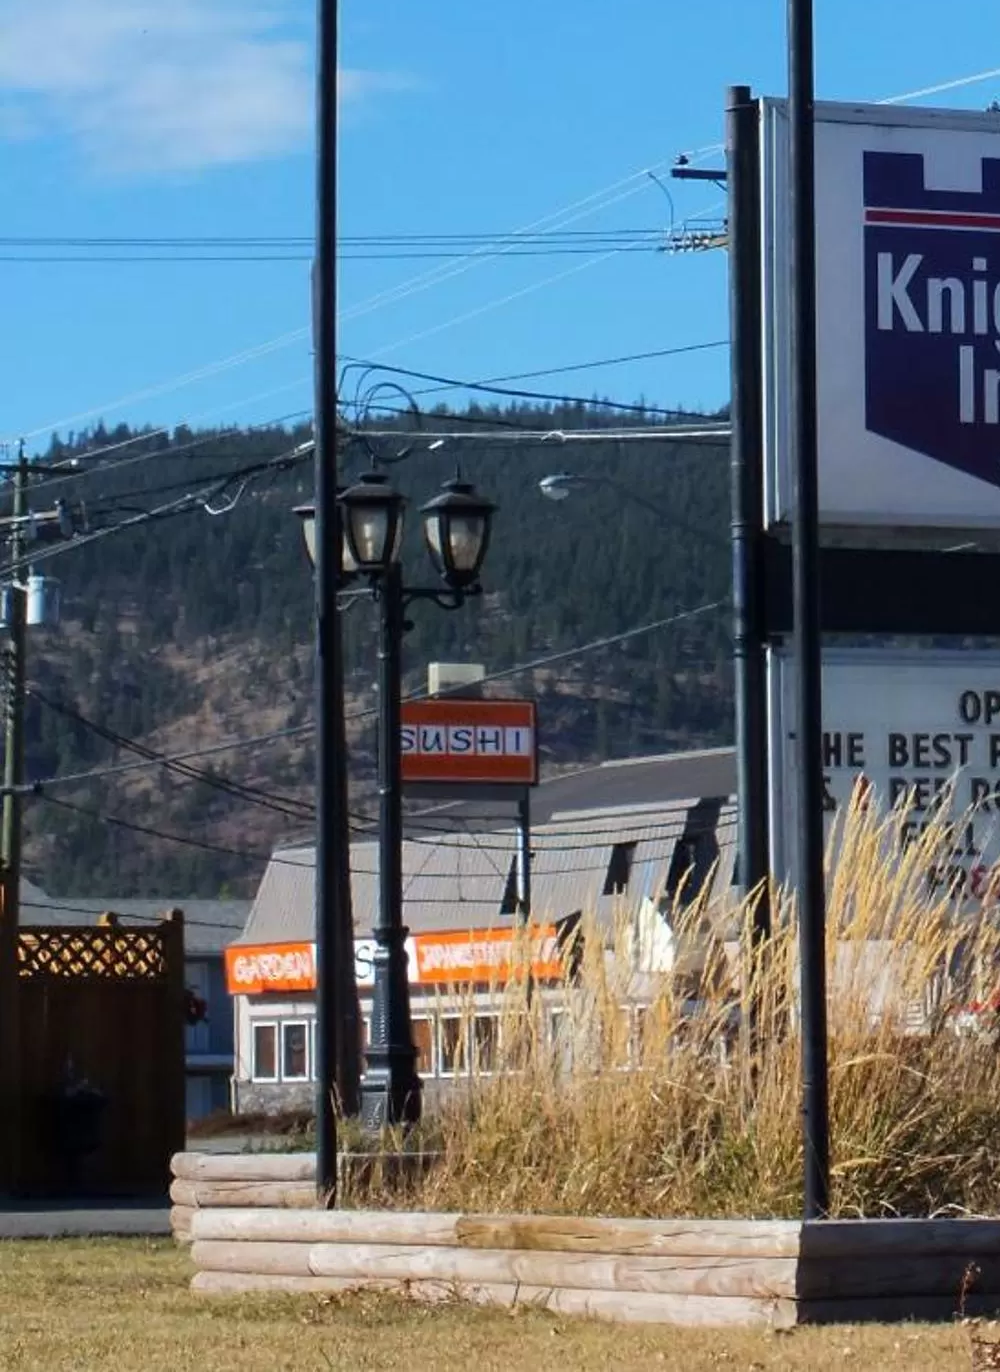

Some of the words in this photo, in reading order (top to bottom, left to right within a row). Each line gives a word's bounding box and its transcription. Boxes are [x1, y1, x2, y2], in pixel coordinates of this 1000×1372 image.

[400, 729, 520, 752] SUSHI
[788, 732, 866, 768] HE
[888, 732, 974, 768] BEST
